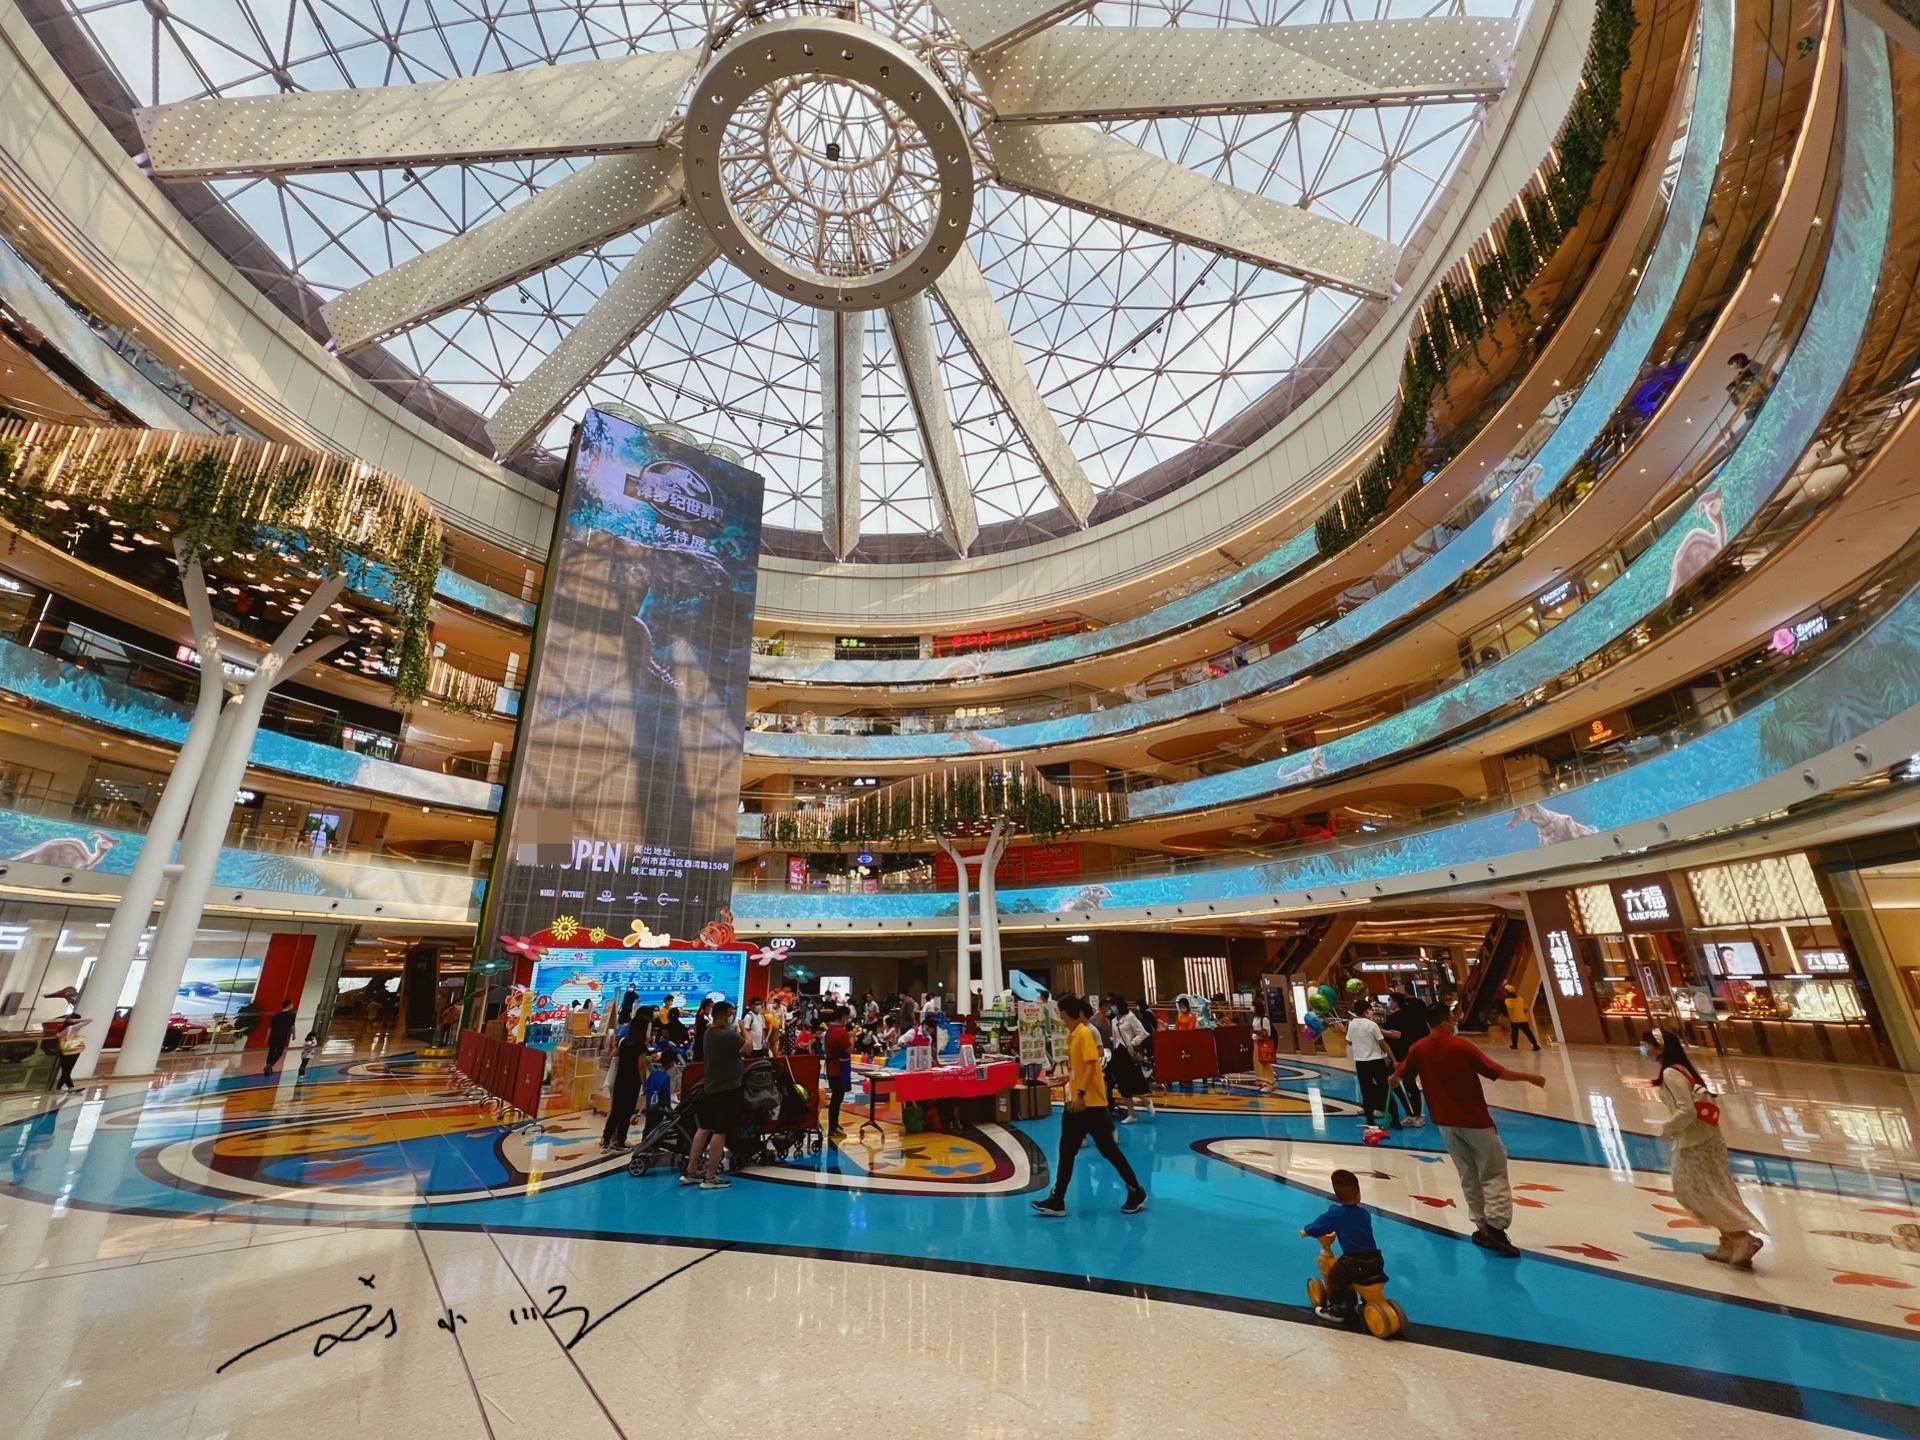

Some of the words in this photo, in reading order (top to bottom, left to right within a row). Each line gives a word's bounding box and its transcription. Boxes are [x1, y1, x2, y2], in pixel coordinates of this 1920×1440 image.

[635, 517, 707, 551] 电影特展
[1621, 886, 1667, 911] 六福
